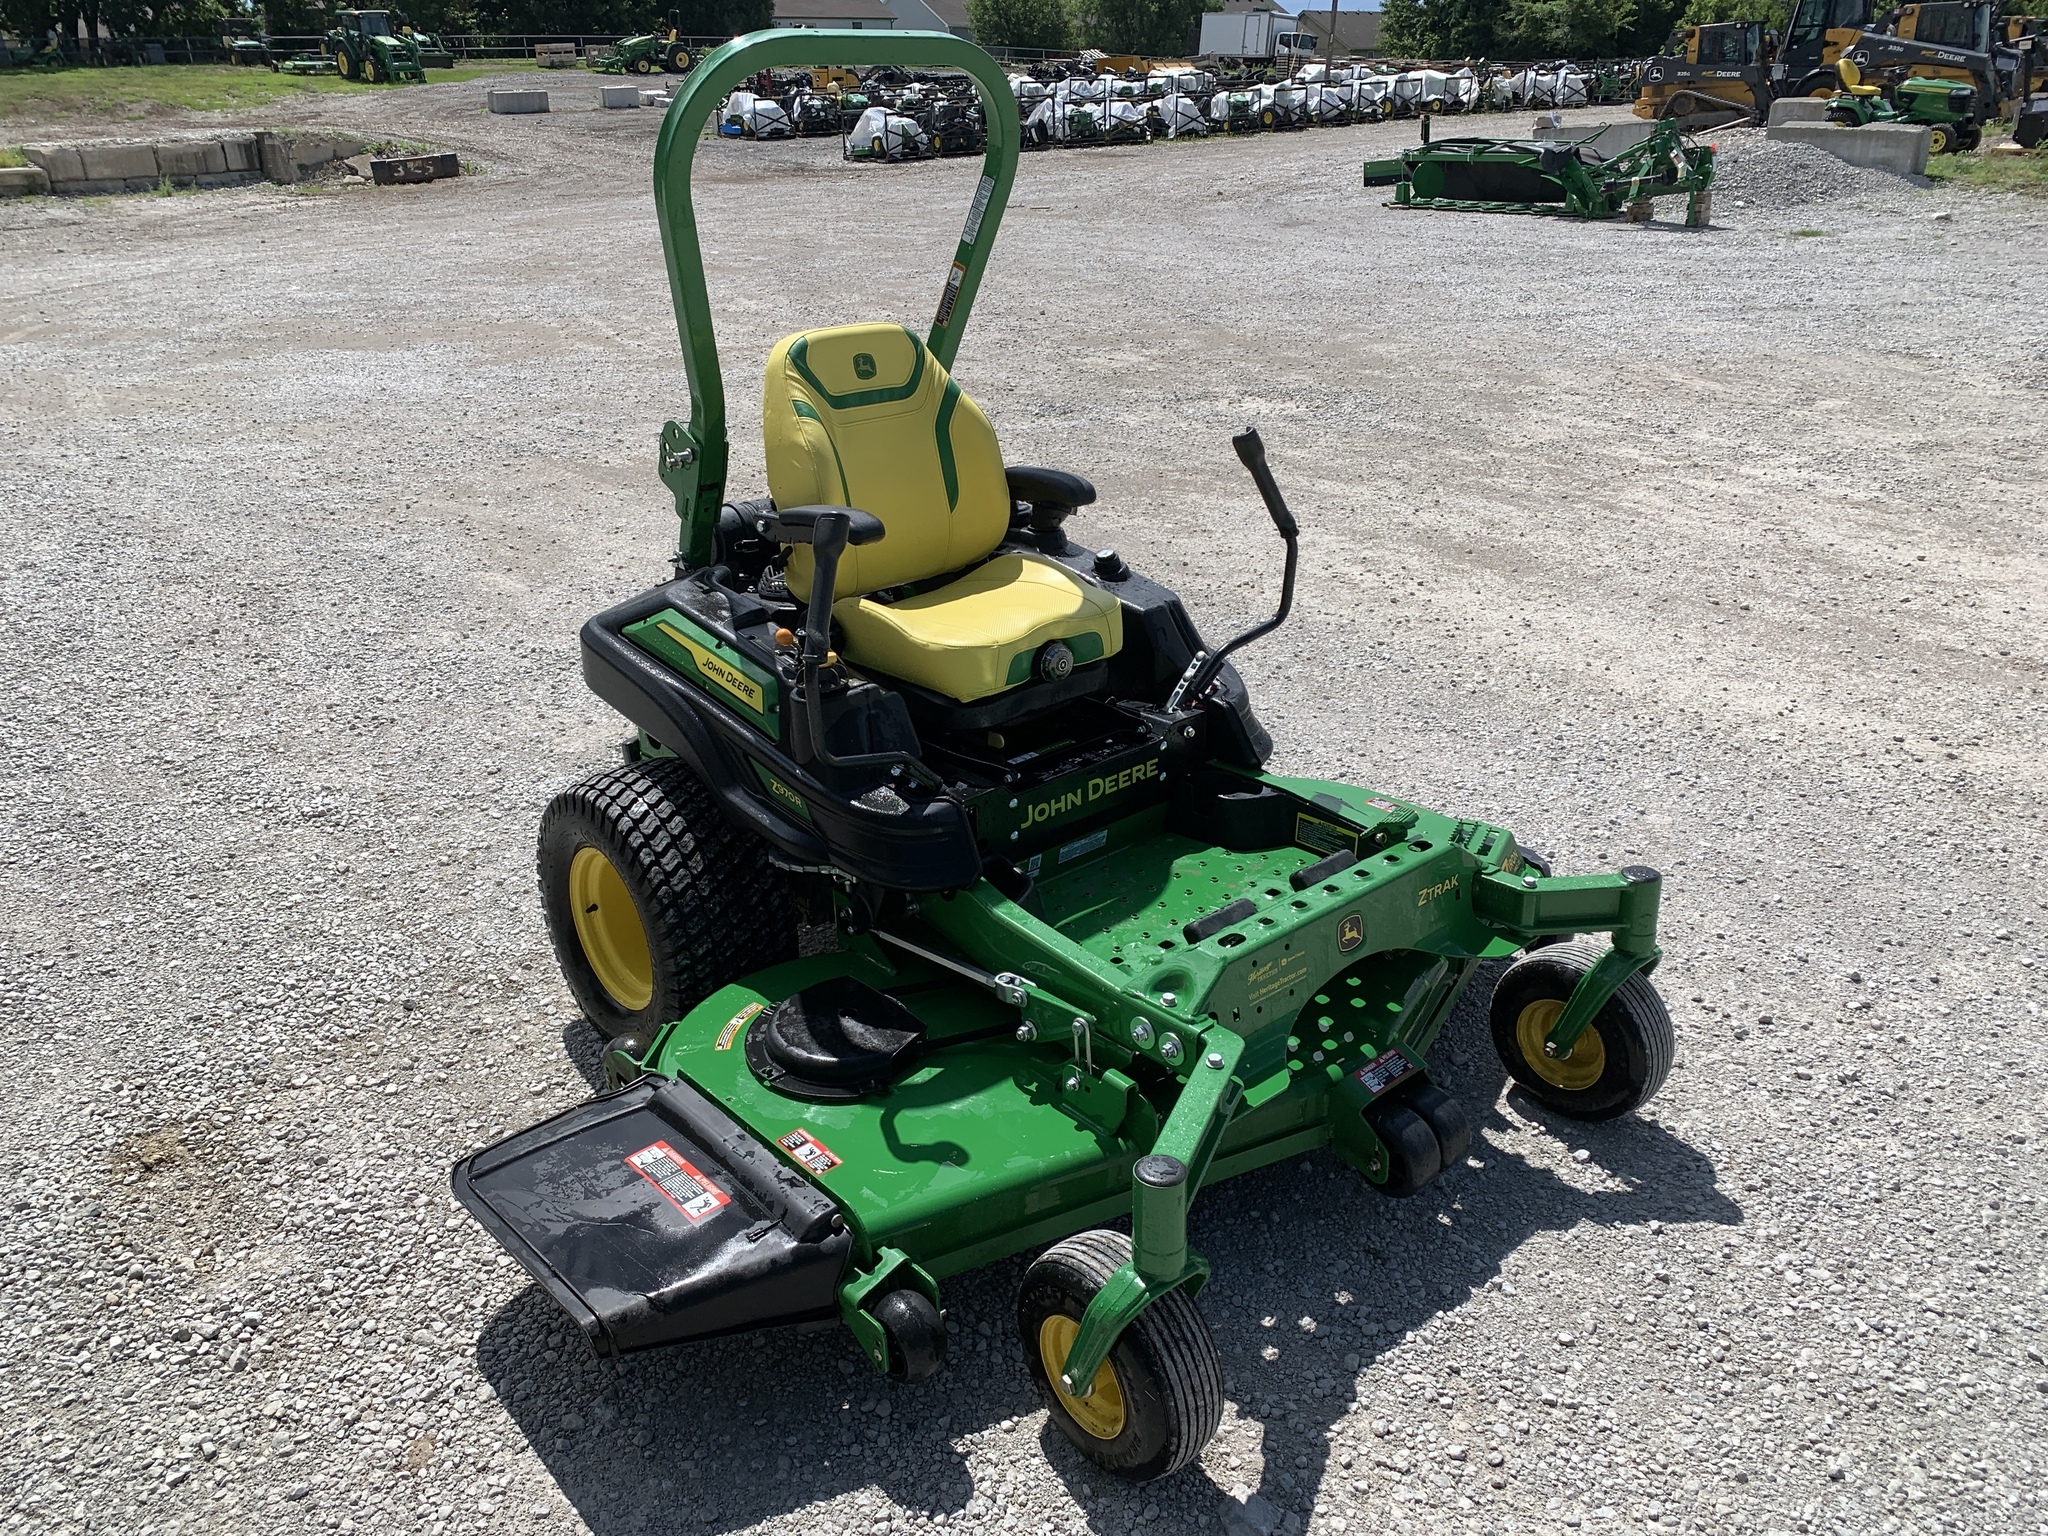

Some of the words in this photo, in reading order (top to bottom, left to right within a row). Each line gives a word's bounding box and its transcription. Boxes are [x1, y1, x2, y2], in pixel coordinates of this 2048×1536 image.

[1937, 51, 1967, 63] DEERE
[1716, 70, 1741, 78] DEERE
[702, 657, 725, 680] JOHN
[725, 671, 756, 699] DEERE
[770, 778, 803, 808] Z970R
[1021, 788, 1082, 829] JOHN
[1088, 758, 1159, 802] DEERE
[1417, 873, 1460, 907] ZTRAK
